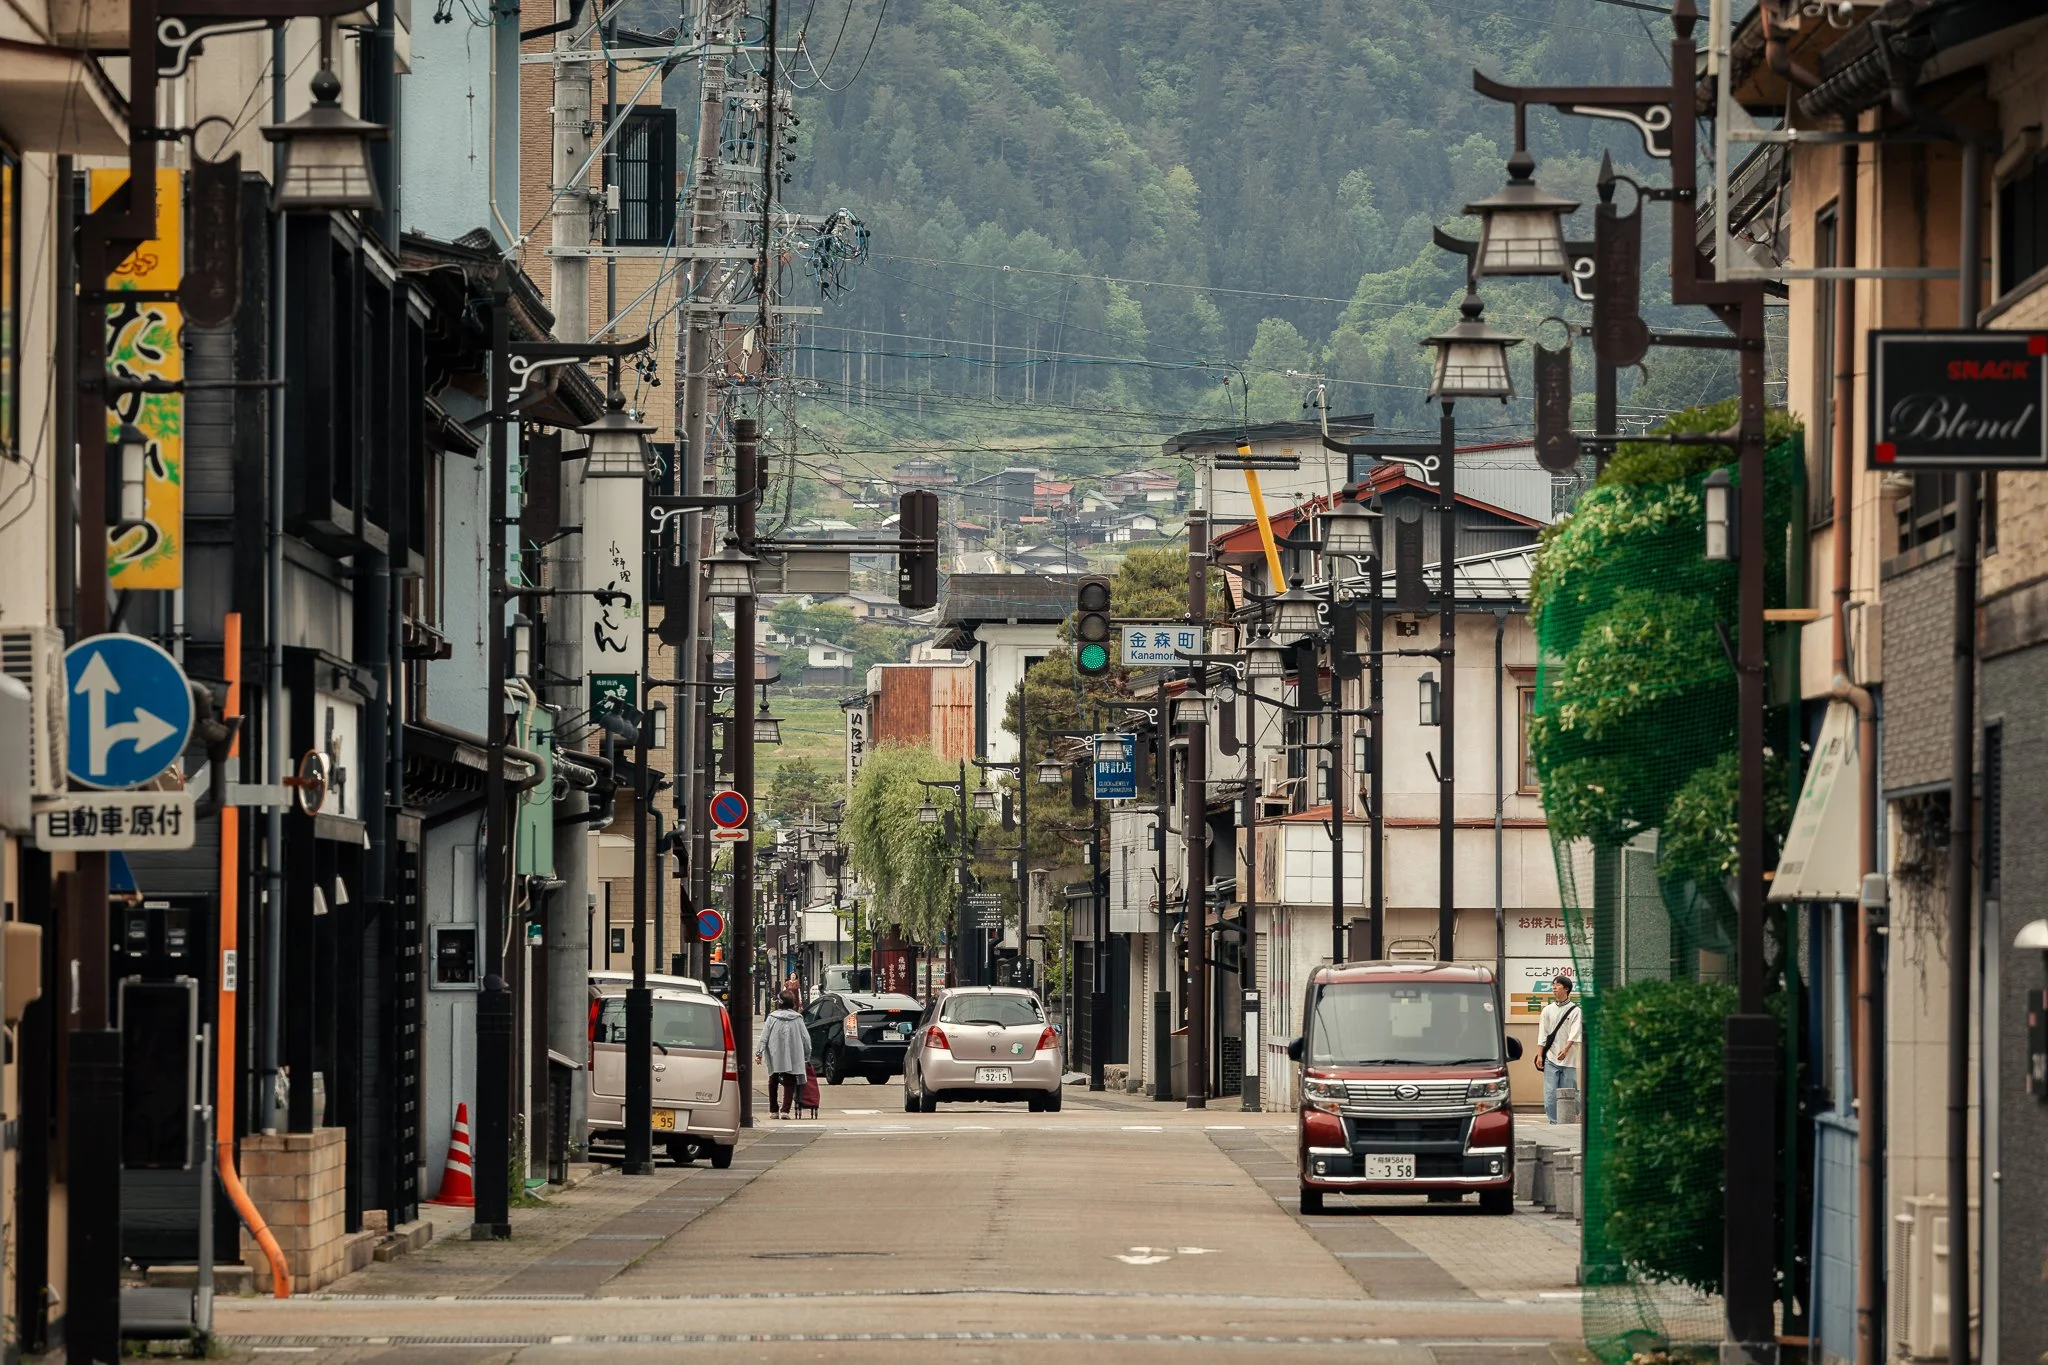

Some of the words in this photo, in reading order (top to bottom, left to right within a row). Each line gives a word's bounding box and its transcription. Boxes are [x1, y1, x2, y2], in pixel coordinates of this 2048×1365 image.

[1947, 360, 2030, 380] SNACK
[1888, 392, 2034, 440] Blend
[1130, 632, 1195, 649] 金森町
[985, 1073, 1007, 1082] 92-15
